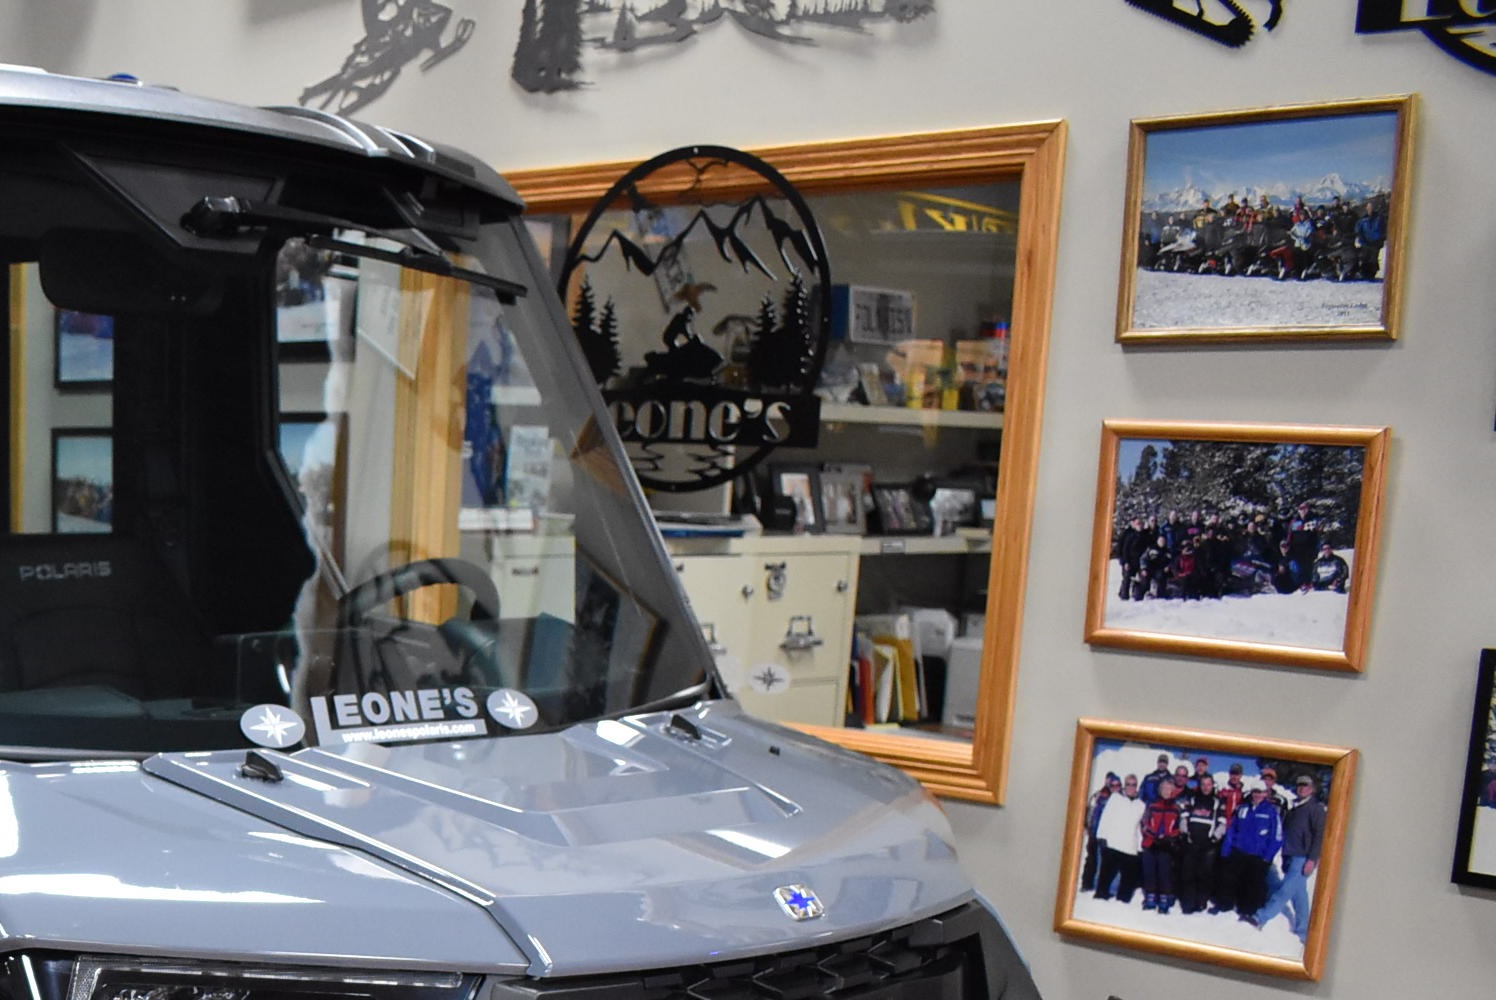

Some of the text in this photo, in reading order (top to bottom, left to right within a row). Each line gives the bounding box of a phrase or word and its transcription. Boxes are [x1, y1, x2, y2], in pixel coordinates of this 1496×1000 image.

[607, 400, 792, 442] eone's
[19, 561, 112, 581] POLARIS
[310, 686, 480, 746] LEONE'S
[340, 721, 476, 744] www.leonespolaris.com
